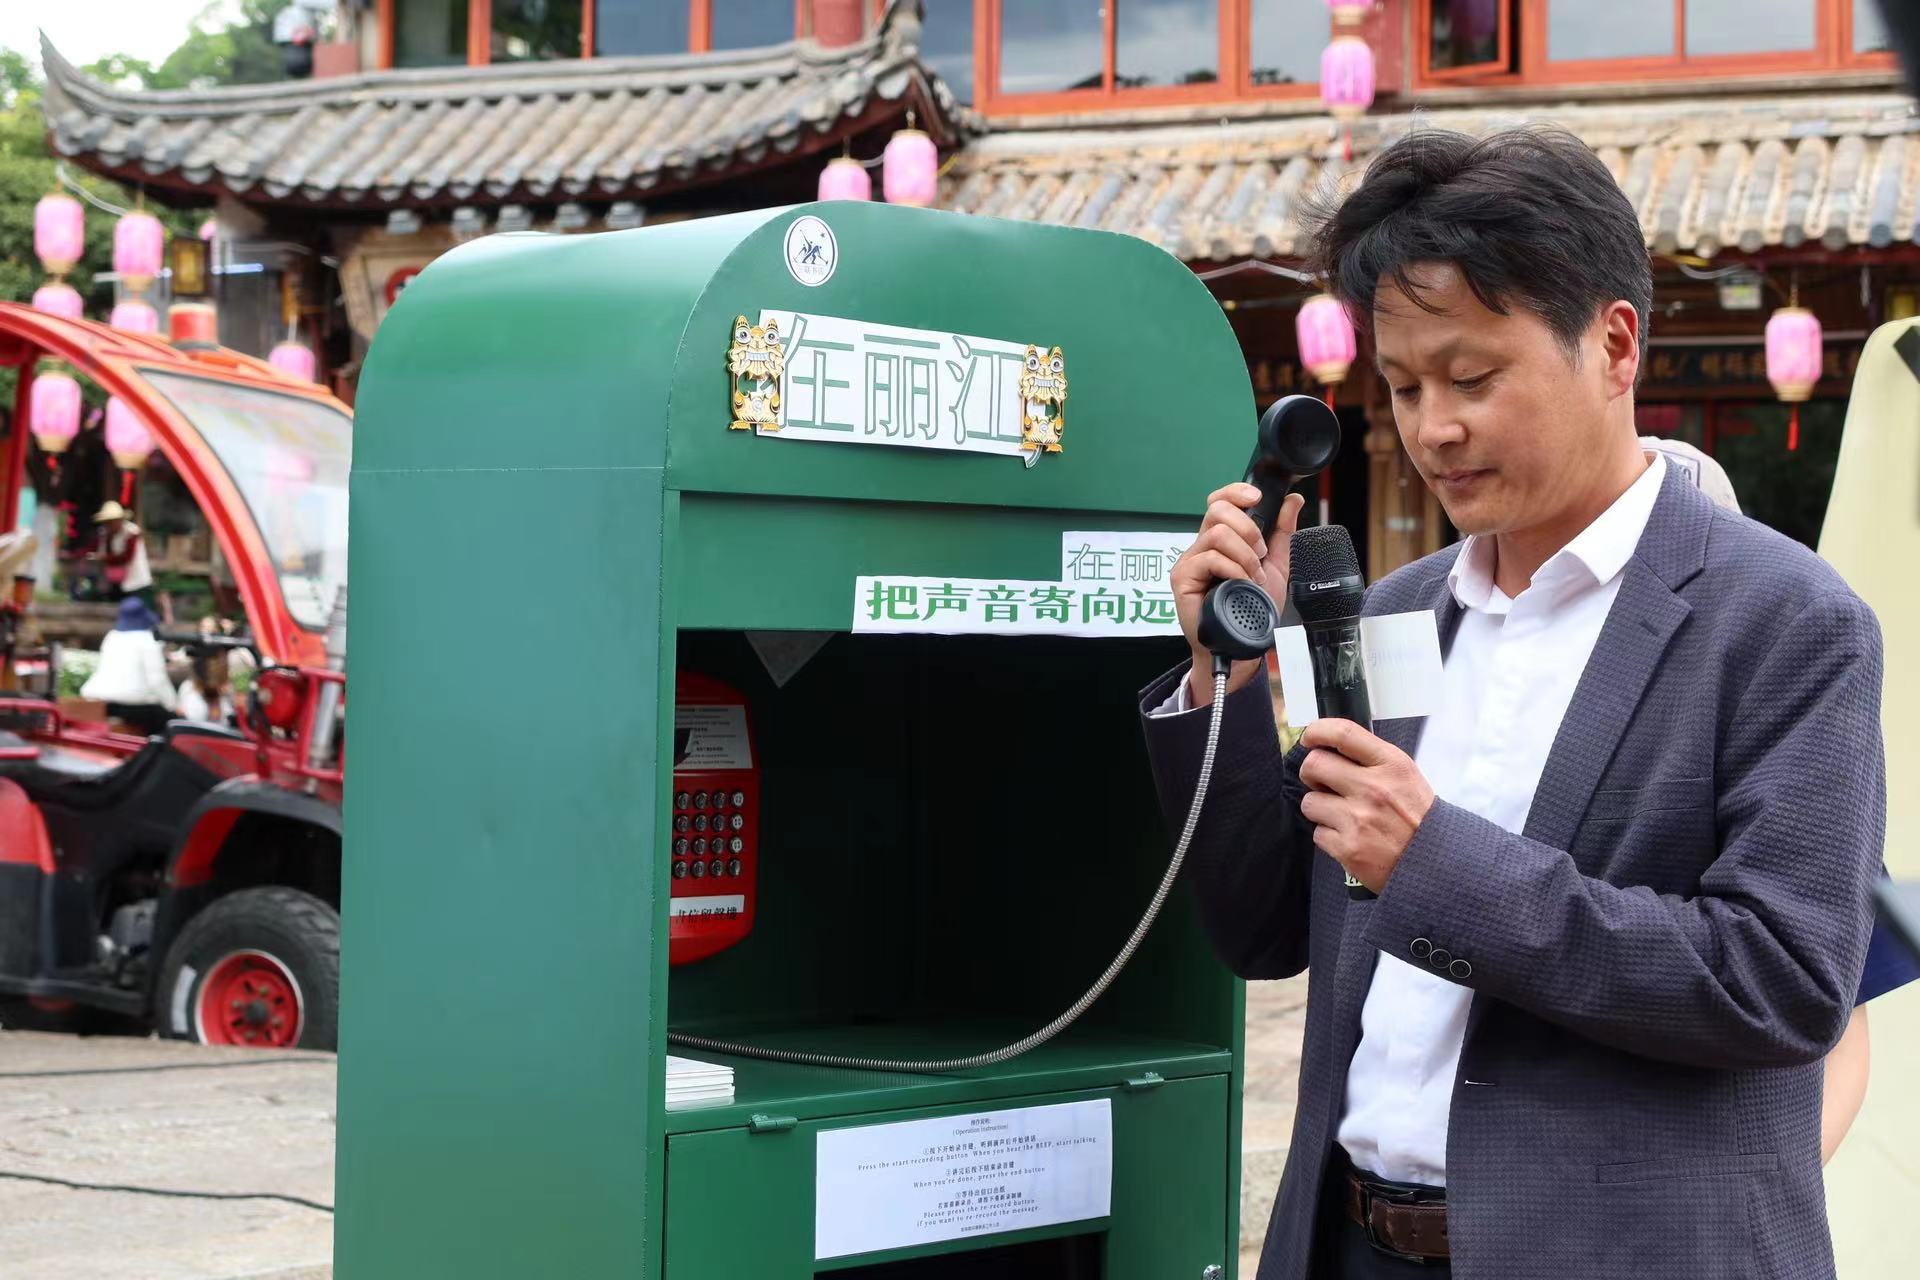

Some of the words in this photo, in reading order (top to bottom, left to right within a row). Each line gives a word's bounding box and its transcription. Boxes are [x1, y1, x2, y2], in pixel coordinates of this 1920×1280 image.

[866, 581, 1181, 624] 把声音寄向远
[857, 1163, 877, 1171] Press
[892, 1159, 909, 1167] start
[911, 1155, 944, 1165] recording
[973, 1149, 991, 1157] When
[992, 1147, 1004, 1155] you
[1006, 1145, 1022, 1153] hear
[1023, 1143, 1033, 1151] the
[1056, 1139, 1072, 1147] start
[1073, 1136, 1097, 1146] talking
[913, 1180, 932, 1188] When
[934, 1175, 956, 1187] you're
[978, 1172, 996, 1182] press
[998, 1170, 1009, 1178] the
[1010, 1168, 1022, 1176] end
[1024, 1166, 1046, 1174] button
[923, 1210, 945, 1219] Please
[947, 1207, 965, 1217] press
[967, 1205, 978, 1213] the
[980, 1202, 1012, 1211] re-record
[1013, 1198, 1035, 1206] button
[924, 1219, 937, 1228] you
[938, 1215, 955, 1224] want
[965, 1210, 997, 1220] re-record
[999, 1208, 1010, 1216] the
